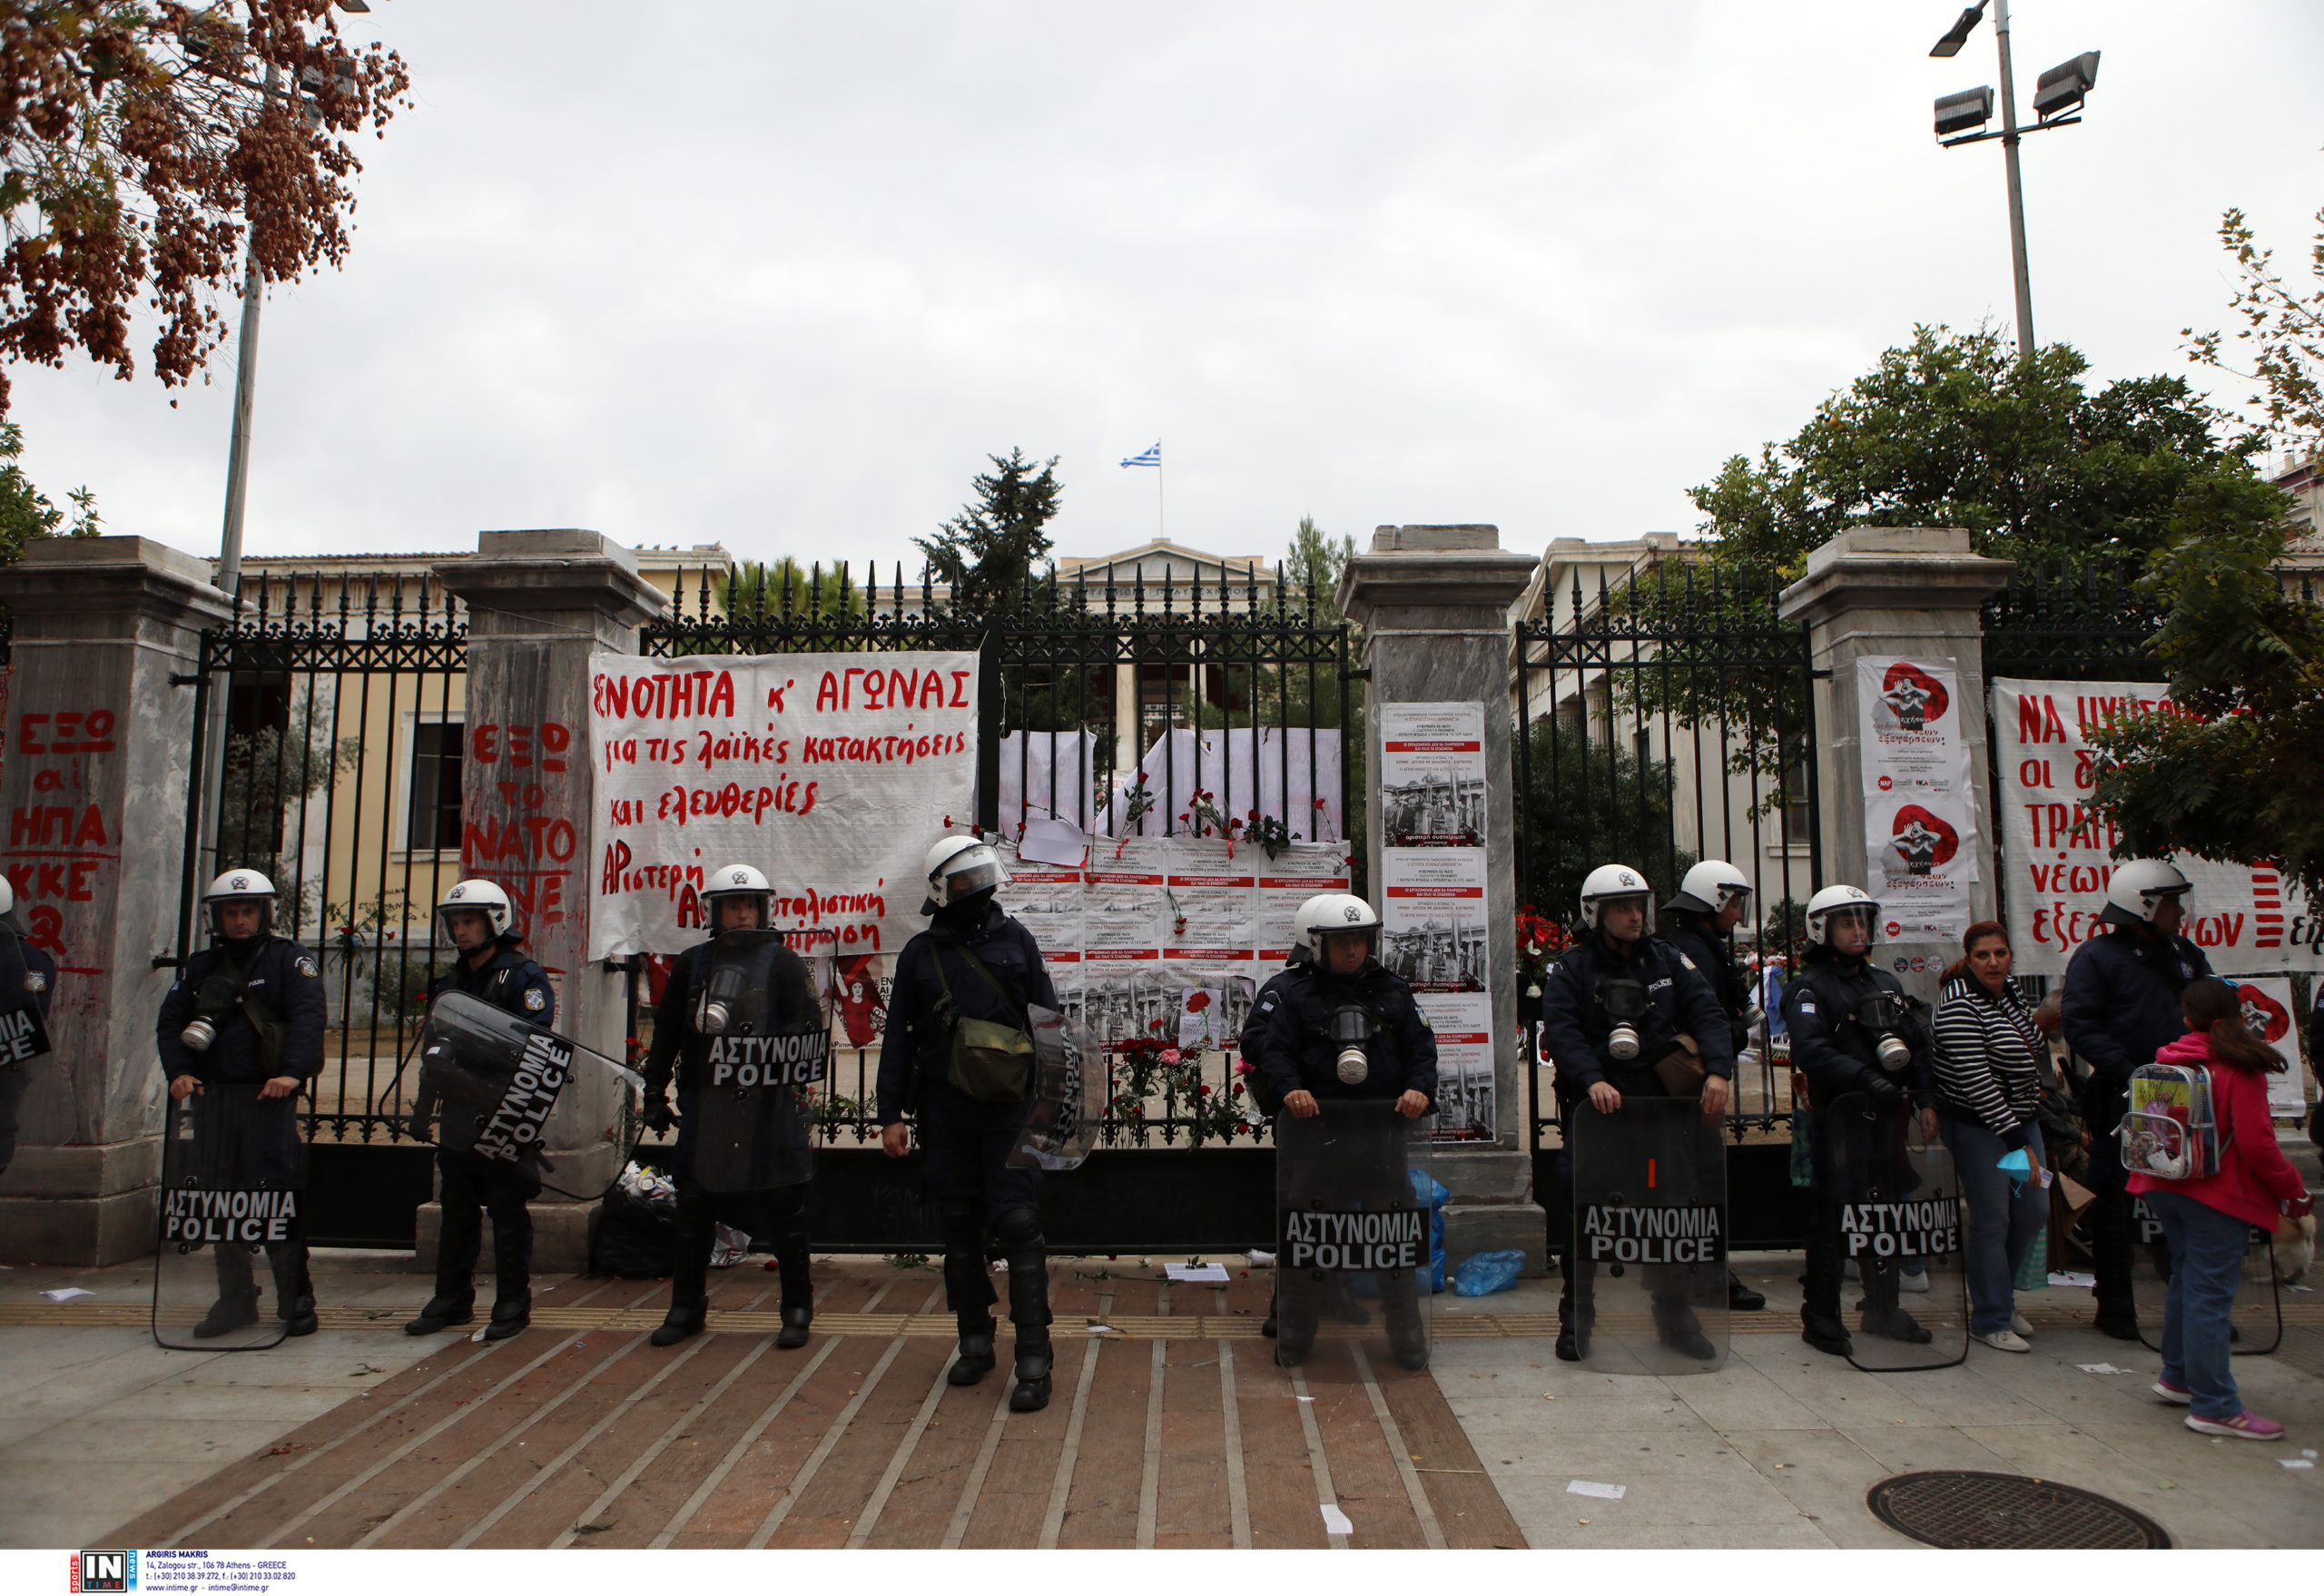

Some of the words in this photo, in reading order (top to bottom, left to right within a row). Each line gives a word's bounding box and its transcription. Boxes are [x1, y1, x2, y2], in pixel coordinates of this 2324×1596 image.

[816, 667, 970, 713] ΑΓΩΝΑΣ
[2018, 695, 2066, 744] ΝΑ
[606, 739, 636, 773] για
[645, 738, 688, 764] τις
[803, 723, 965, 764] κατακτήσεις
[610, 799, 644, 826] και
[658, 773, 819, 825] ελευθερίες
[11, 803, 107, 846] ΗΠΑ
[463, 814, 576, 862] ΝΑΤΟ
[8, 862, 99, 901] ΚΚΕ
[499, 876, 564, 924] ΝΕ
[708, 1032, 826, 1063] ΑΣΤΥΝΟΜΙΑ
[714, 1059, 822, 1086] POLICE
[473, 1033, 554, 1160] ΑΣΤΥΝΟΜΙΑ
[500, 1046, 571, 1162] POLICE
[165, 1189, 296, 1218] ΑΣΤΥΝΟΜΙΑ
[1584, 1206, 1719, 1237] ΑΣΤΥΝΟΜΙΑ
[1841, 1199, 1957, 1233] ΑΣΤΥΝΟΜΙΑ
[167, 1217, 288, 1241] POLICE
[1286, 1211, 1422, 1243] ΑΣΤΥΝΟΜΙΑ
[1849, 1227, 1957, 1256] POLICE
[1293, 1242, 1416, 1269] POLICE
[1591, 1236, 1714, 1263] POLICE
